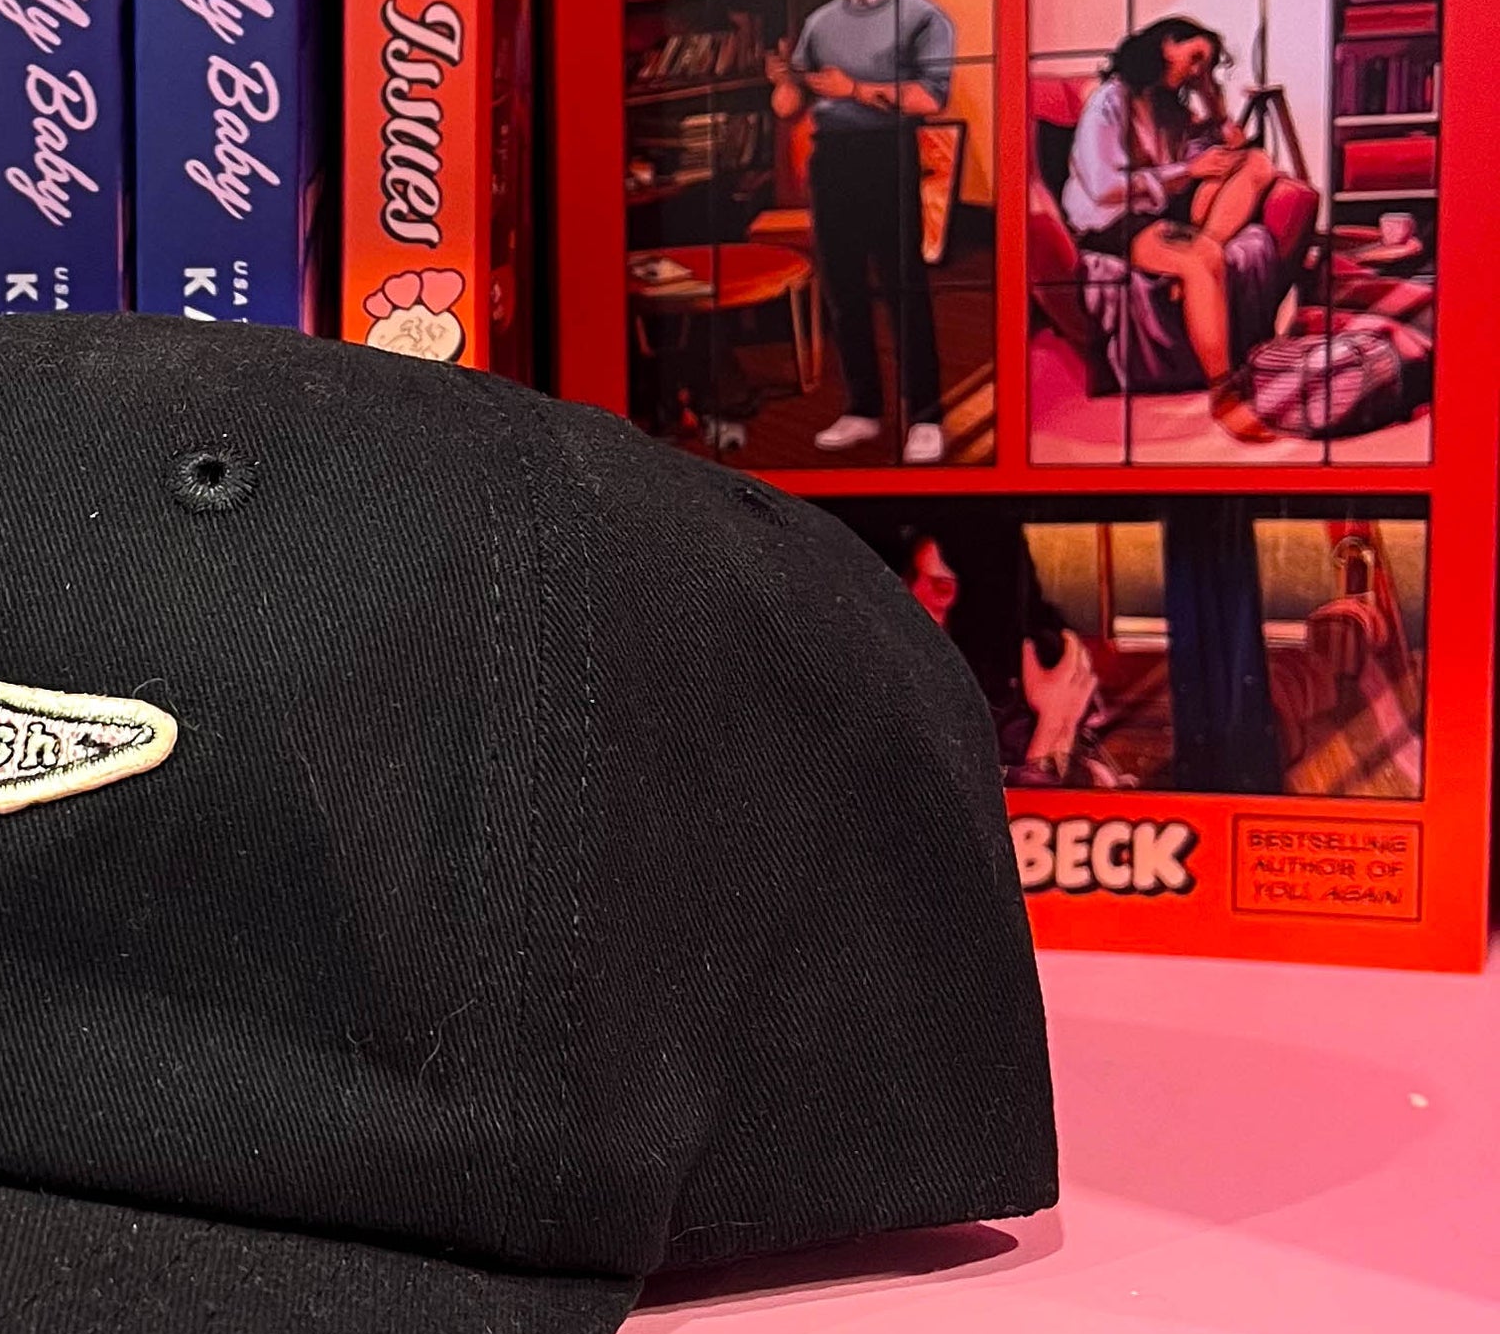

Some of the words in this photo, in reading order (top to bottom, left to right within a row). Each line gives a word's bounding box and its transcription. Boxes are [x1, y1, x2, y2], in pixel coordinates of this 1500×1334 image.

[5, 64, 98, 229] Baby
[185, 54, 281, 221] Baby
[233, 260, 248, 305] USA
[1008, 815, 1200, 895] BECK
